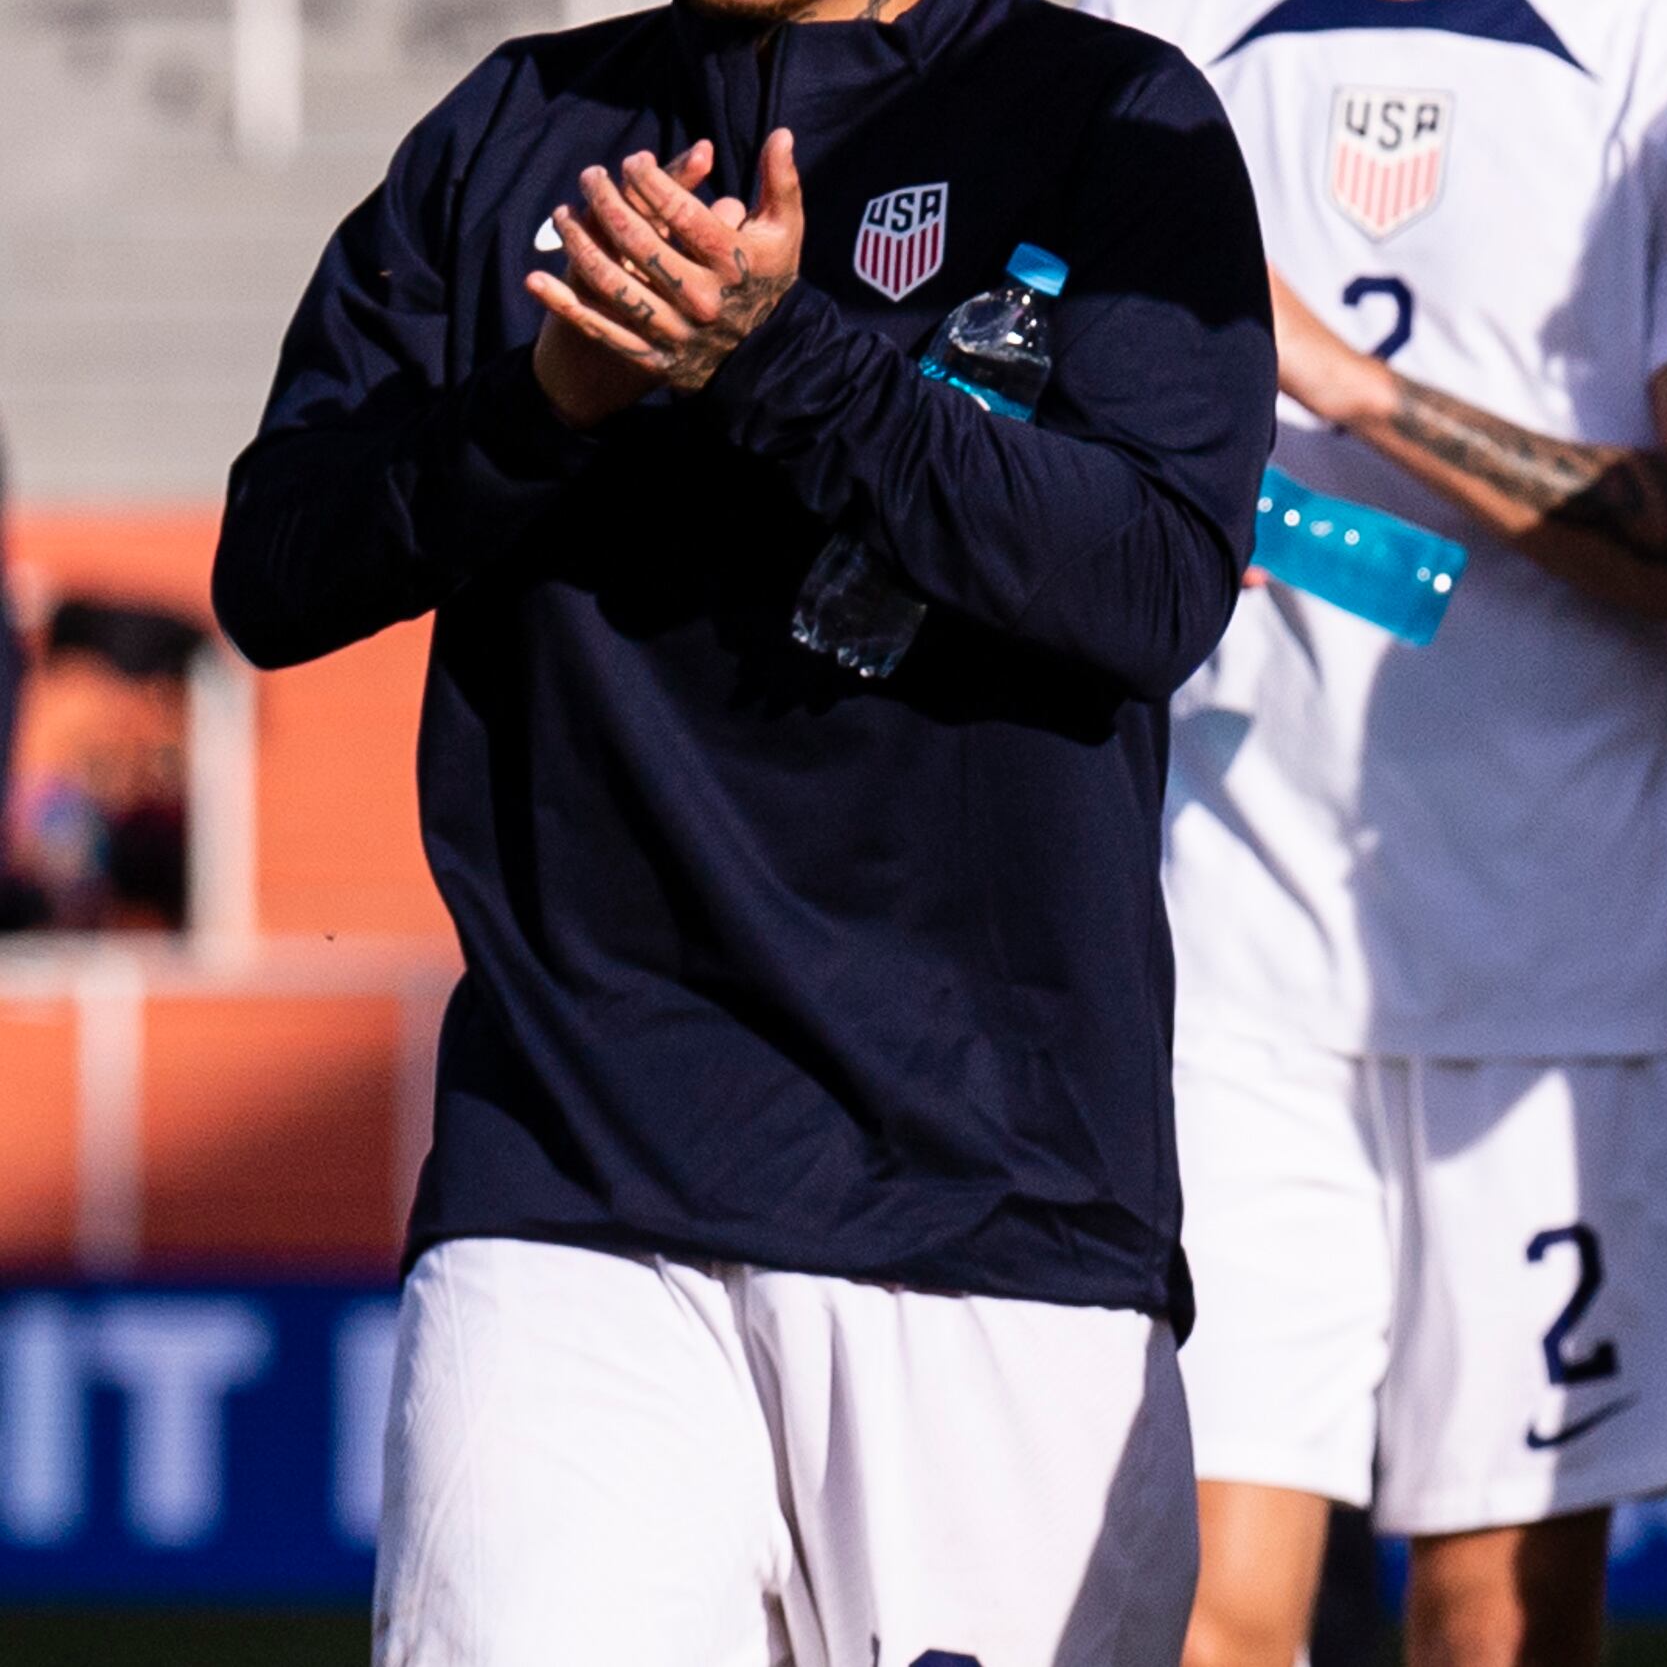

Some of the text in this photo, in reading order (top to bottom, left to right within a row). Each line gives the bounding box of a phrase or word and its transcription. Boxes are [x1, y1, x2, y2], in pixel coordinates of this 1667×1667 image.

[1344, 98, 1441, 151] USA
[866, 189, 943, 234] USA
[1342, 276, 1414, 362] 2
[1526, 1222, 1621, 1384] 2
